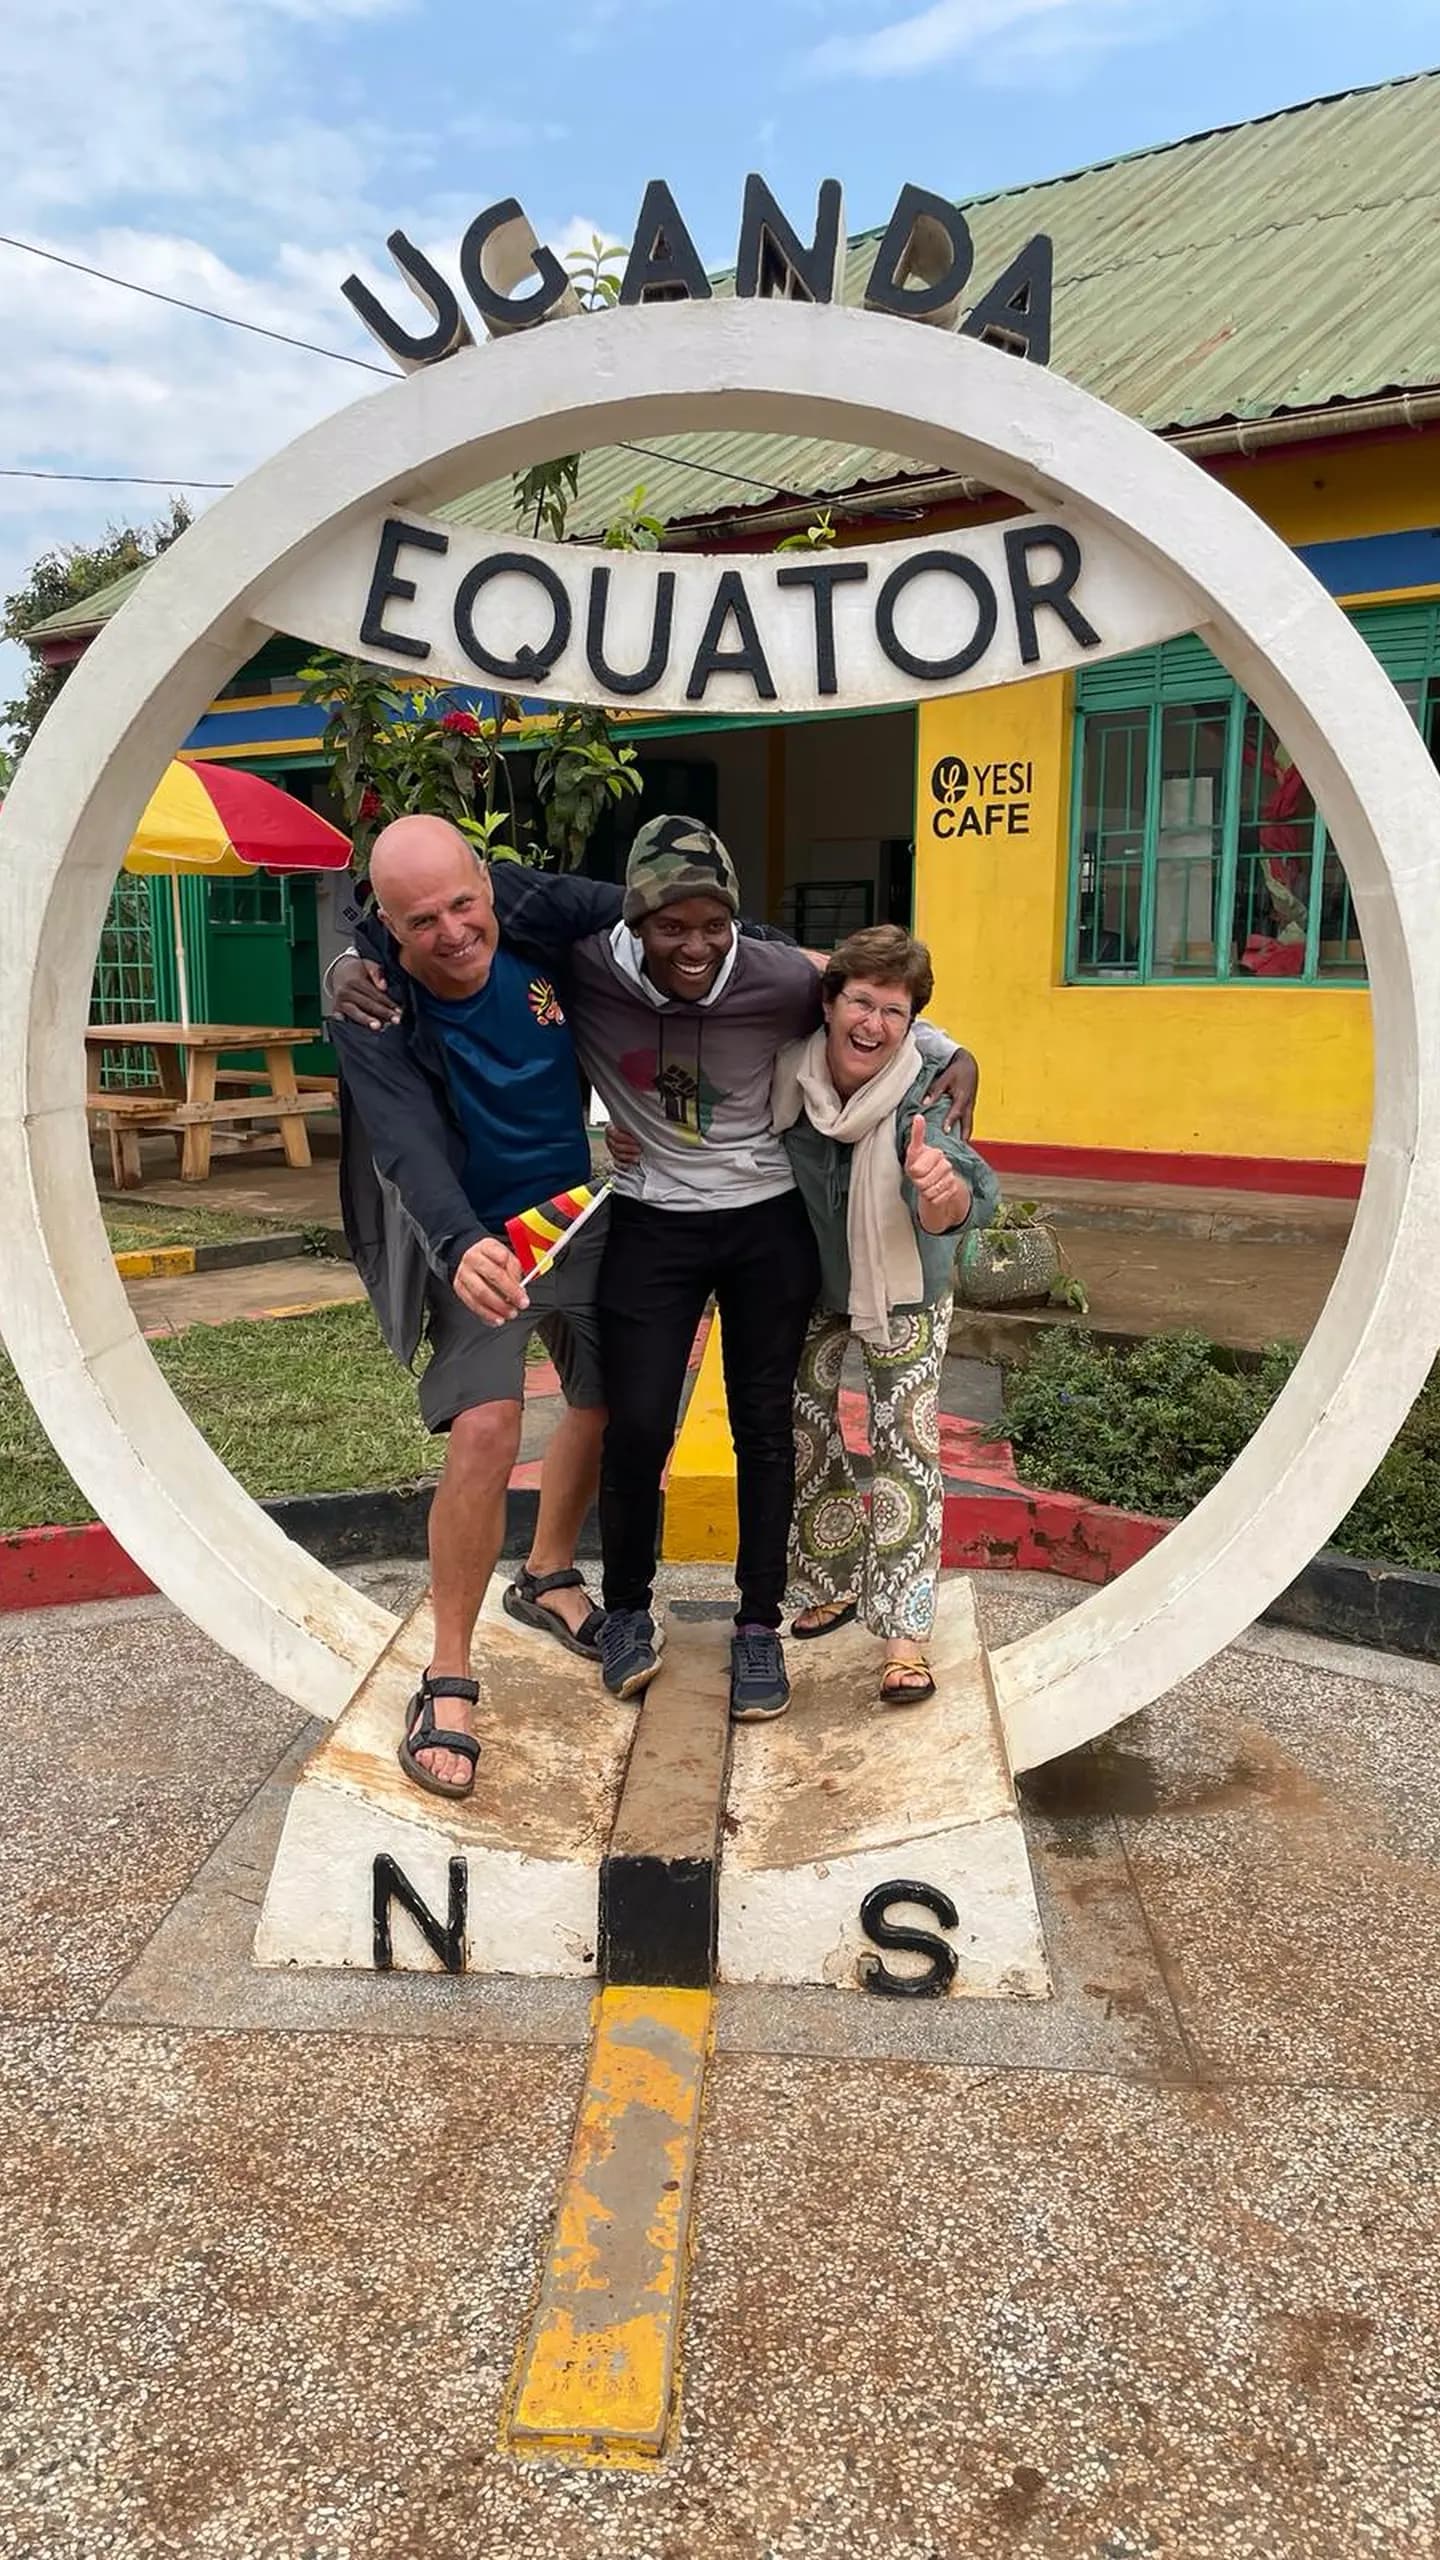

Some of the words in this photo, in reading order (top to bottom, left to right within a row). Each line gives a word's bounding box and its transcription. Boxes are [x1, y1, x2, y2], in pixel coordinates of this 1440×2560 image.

[341, 173, 1054, 365] UGANDA
[360, 520, 1102, 701] EQUATOR
[932, 802, 1030, 839] CAFE
[973, 761, 1033, 797] YESI
[373, 1853, 468, 1973] N
[859, 1880, 960, 1997] S
